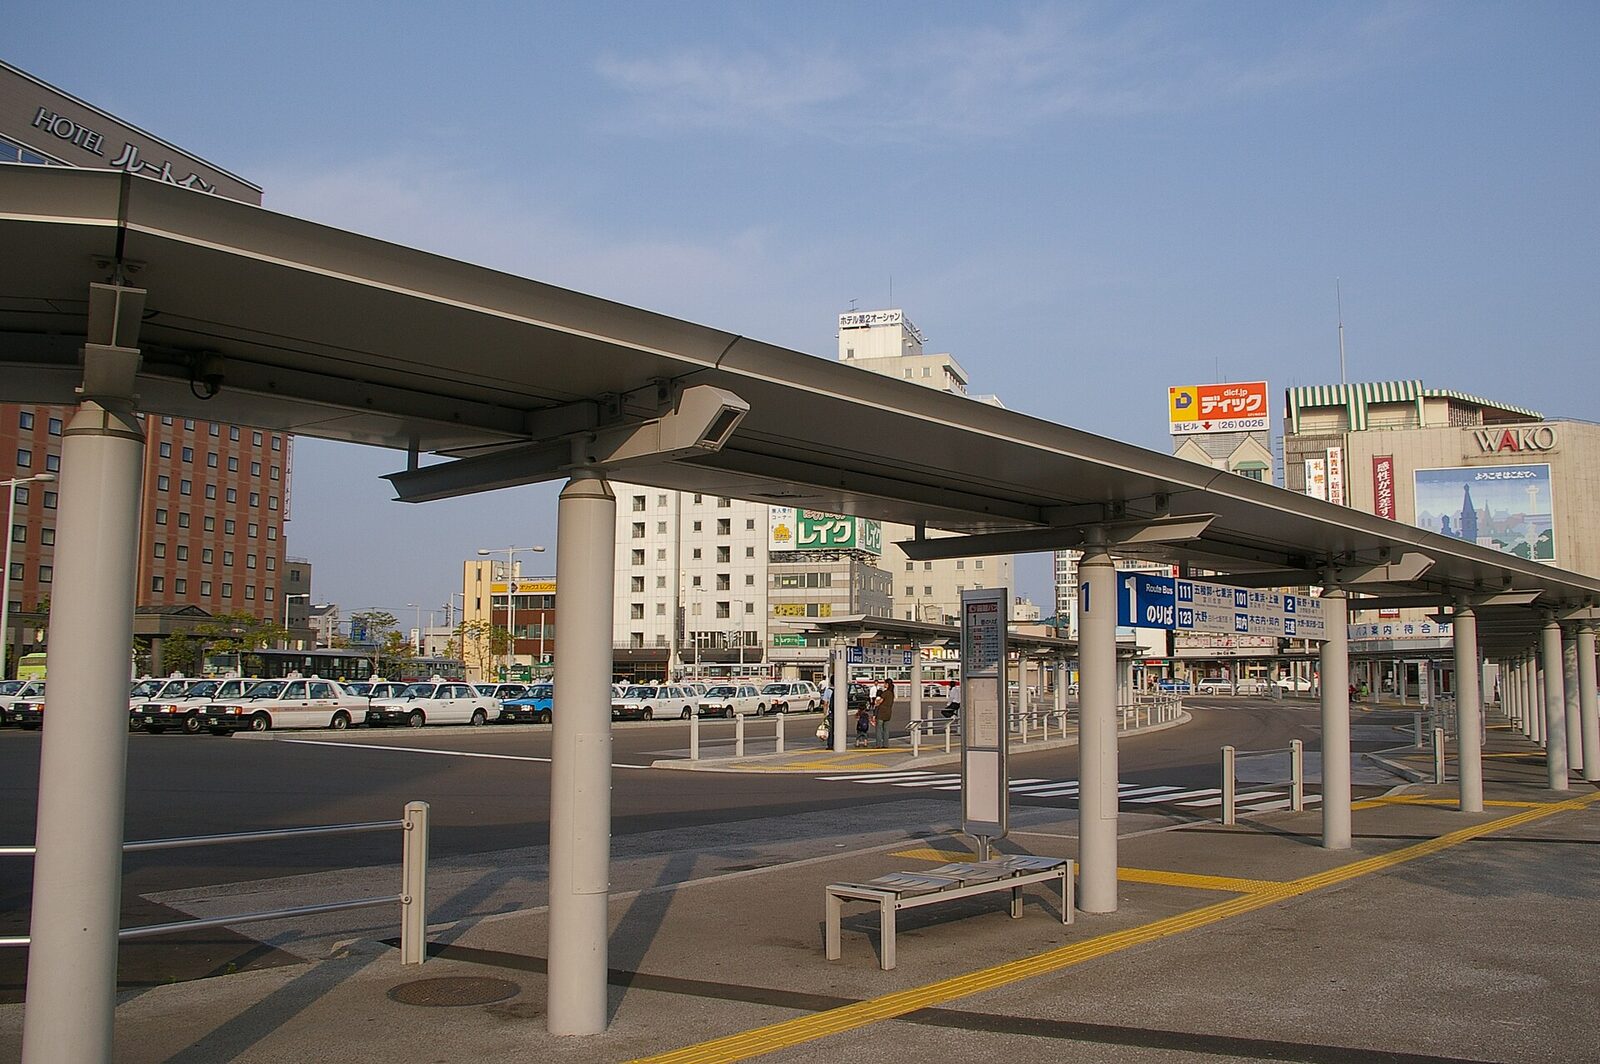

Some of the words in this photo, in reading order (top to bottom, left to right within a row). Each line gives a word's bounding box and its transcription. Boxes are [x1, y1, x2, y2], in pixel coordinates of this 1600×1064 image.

[32, 107, 104, 157] HOTEL
[1201, 394, 1262, 414] ディック
[1218, 420, 1264, 429] (26)0026
[1474, 426, 1557, 452] WAKO
[798, 521, 852, 544] レイク
[866, 523, 880, 548] レイク
[1146, 583, 1162, 593] Route
[1162, 585, 1174, 595] Bus
[1179, 585, 1191, 599] 111
[1081, 582, 1090, 612] 1
[1125, 576, 1137, 623] 1
[1236, 592, 1246, 605] 101
[1287, 599, 1293, 610] 2
[973, 614, 977, 626] 1
[1147, 605, 1174, 625] のりば
[1179, 611, 1192, 625] 123
[1195, 610, 1208, 622] 大野
[1236, 615, 1247, 630] 知内
